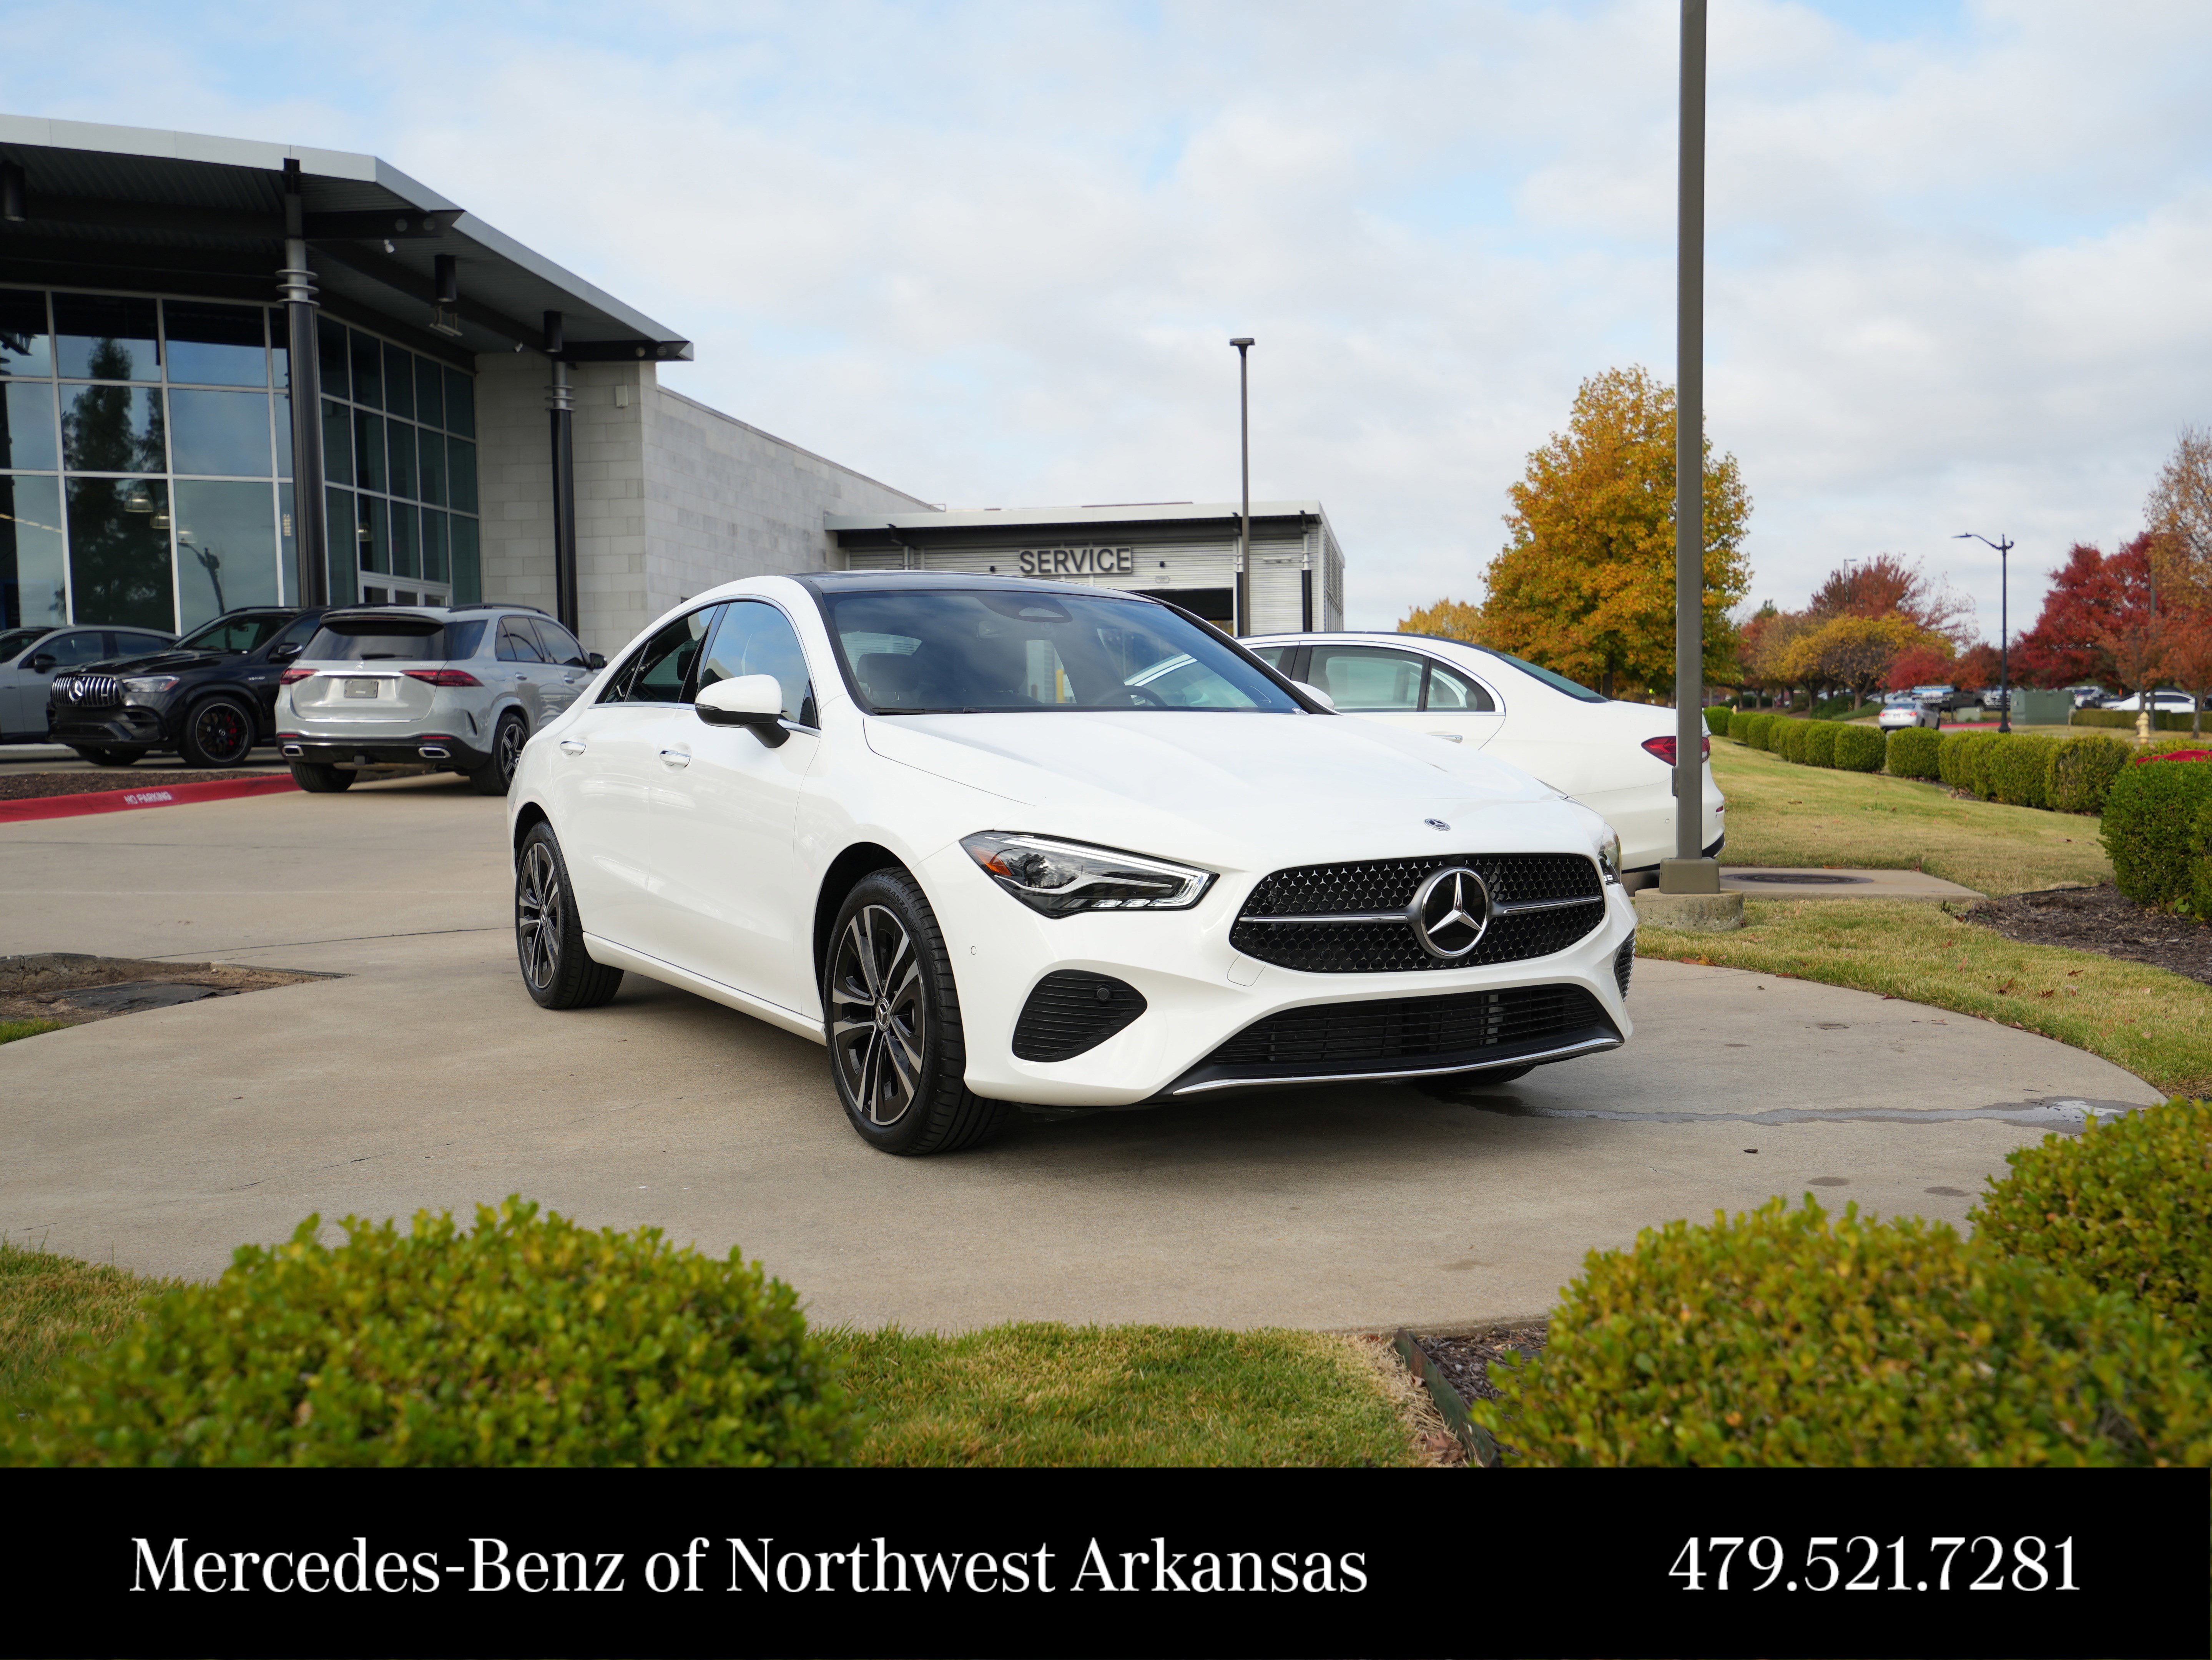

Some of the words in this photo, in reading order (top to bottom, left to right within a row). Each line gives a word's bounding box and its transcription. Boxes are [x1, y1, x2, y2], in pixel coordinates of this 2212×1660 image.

[1020, 548, 1130, 574] SERVICE
[123, 794, 138, 805] NO
[136, 791, 172, 803] PARKING
[879, 882, 909, 914] TURANZA
